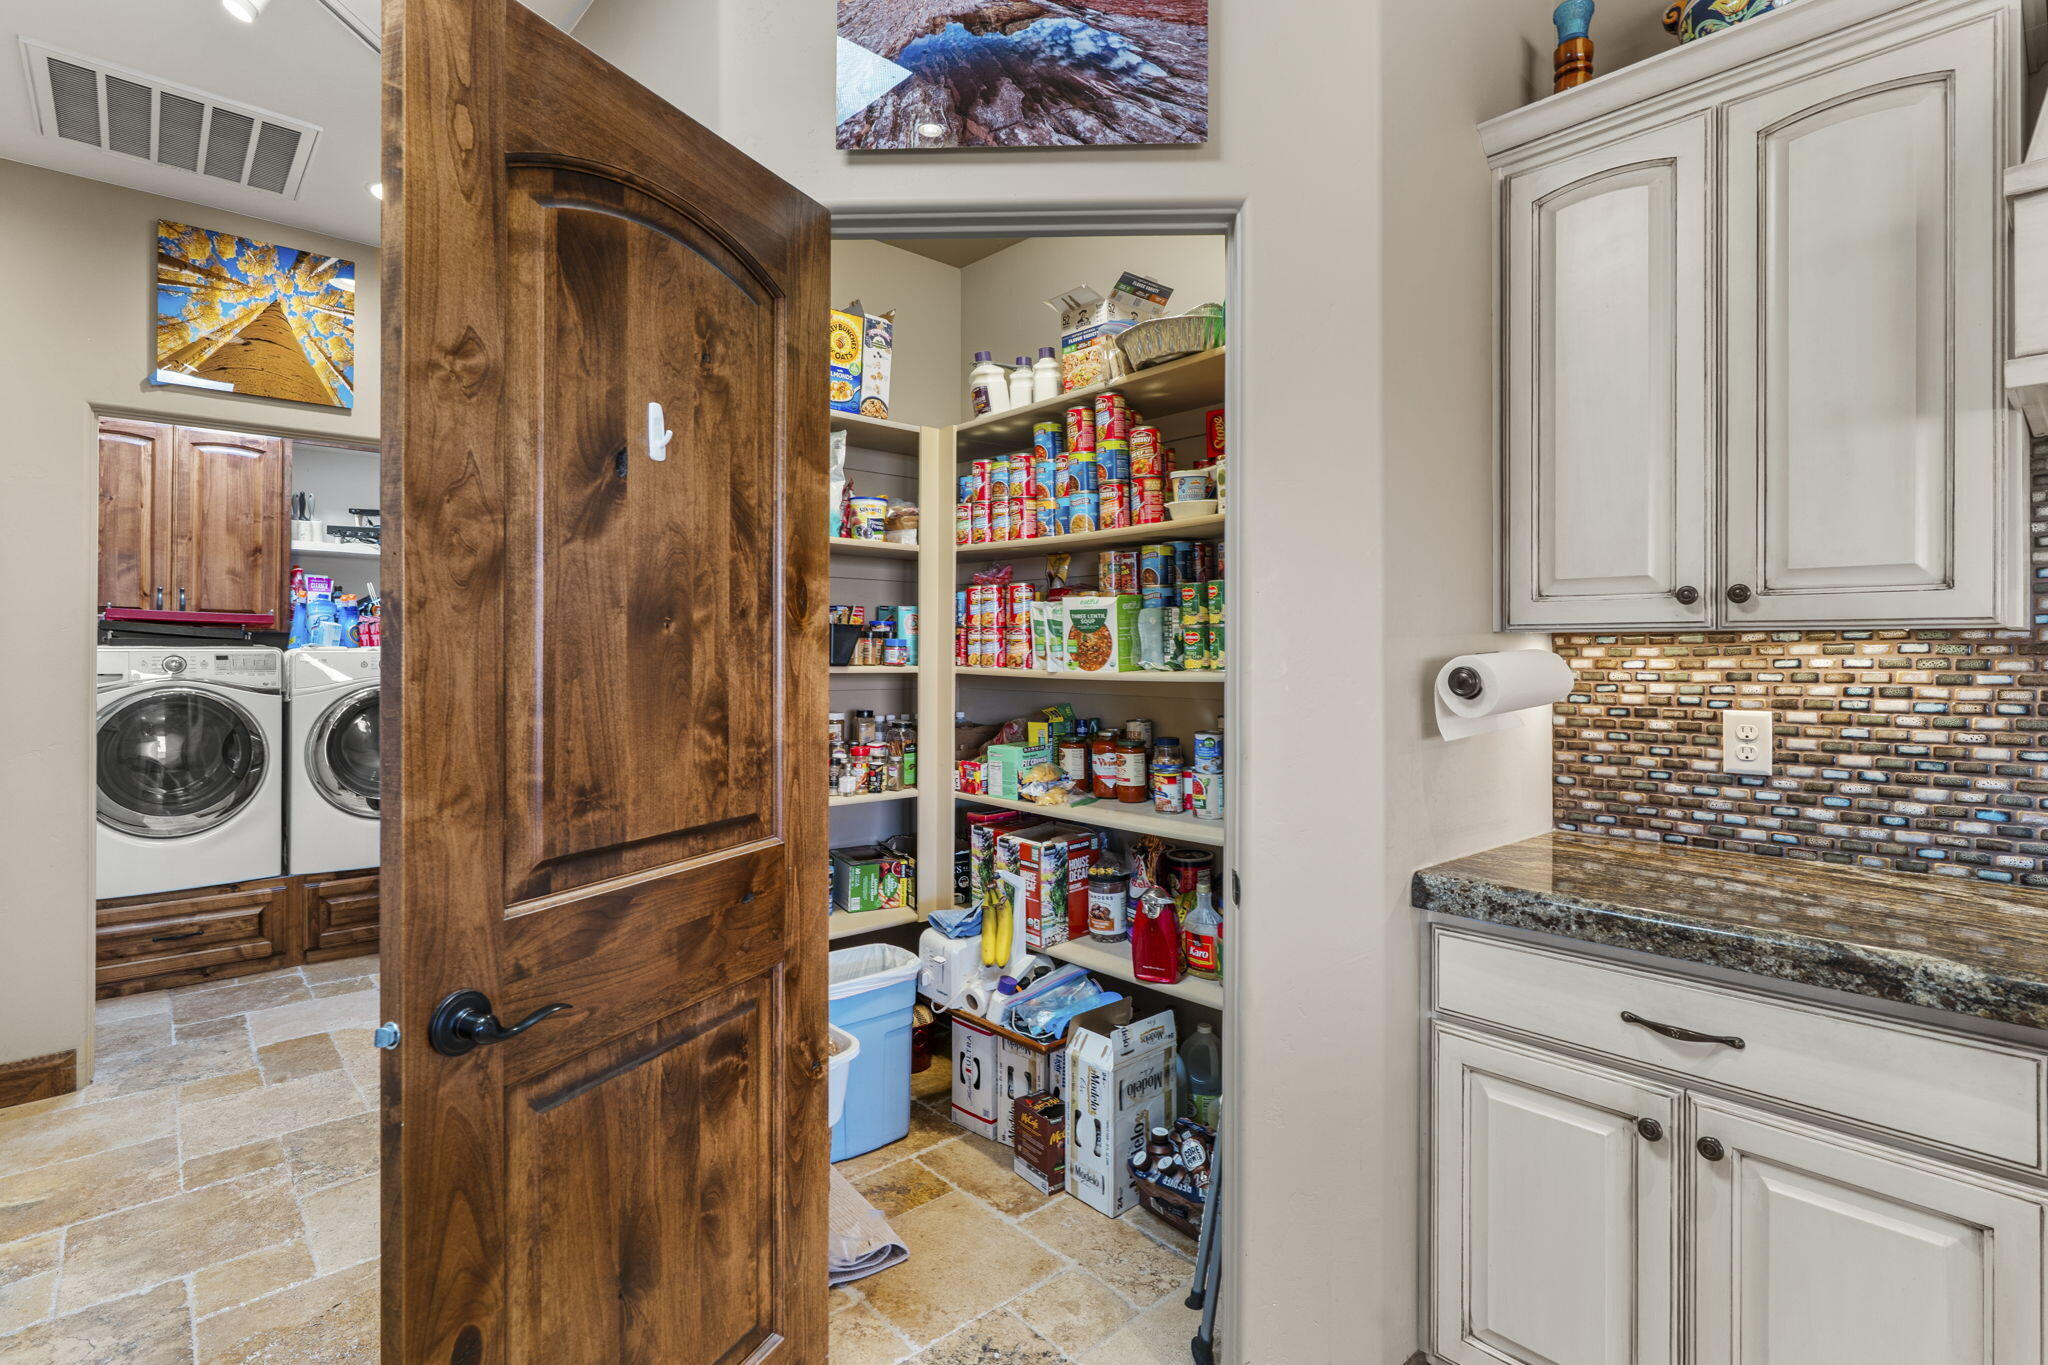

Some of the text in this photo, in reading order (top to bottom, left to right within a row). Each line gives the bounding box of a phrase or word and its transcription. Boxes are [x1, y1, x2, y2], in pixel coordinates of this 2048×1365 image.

[1062, 314, 1071, 326] 52
[838, 323, 857, 351] BUNCHES
[834, 351, 854, 360] OATS
[830, 371, 854, 381] LMONDS
[1069, 855, 1090, 871] HOUSE
[1190, 946, 1209, 959] Karo
[1055, 1054, 1063, 1075] Light
[1090, 1069, 1101, 1111] Modelo
[1127, 1072, 1163, 1097] Modelo
[1184, 1145, 1201, 1160] CORE
[1187, 1154, 1203, 1166] POWER
[1075, 1165, 1100, 1188] Modelo
[1162, 1177, 1192, 1194] RECOVER
